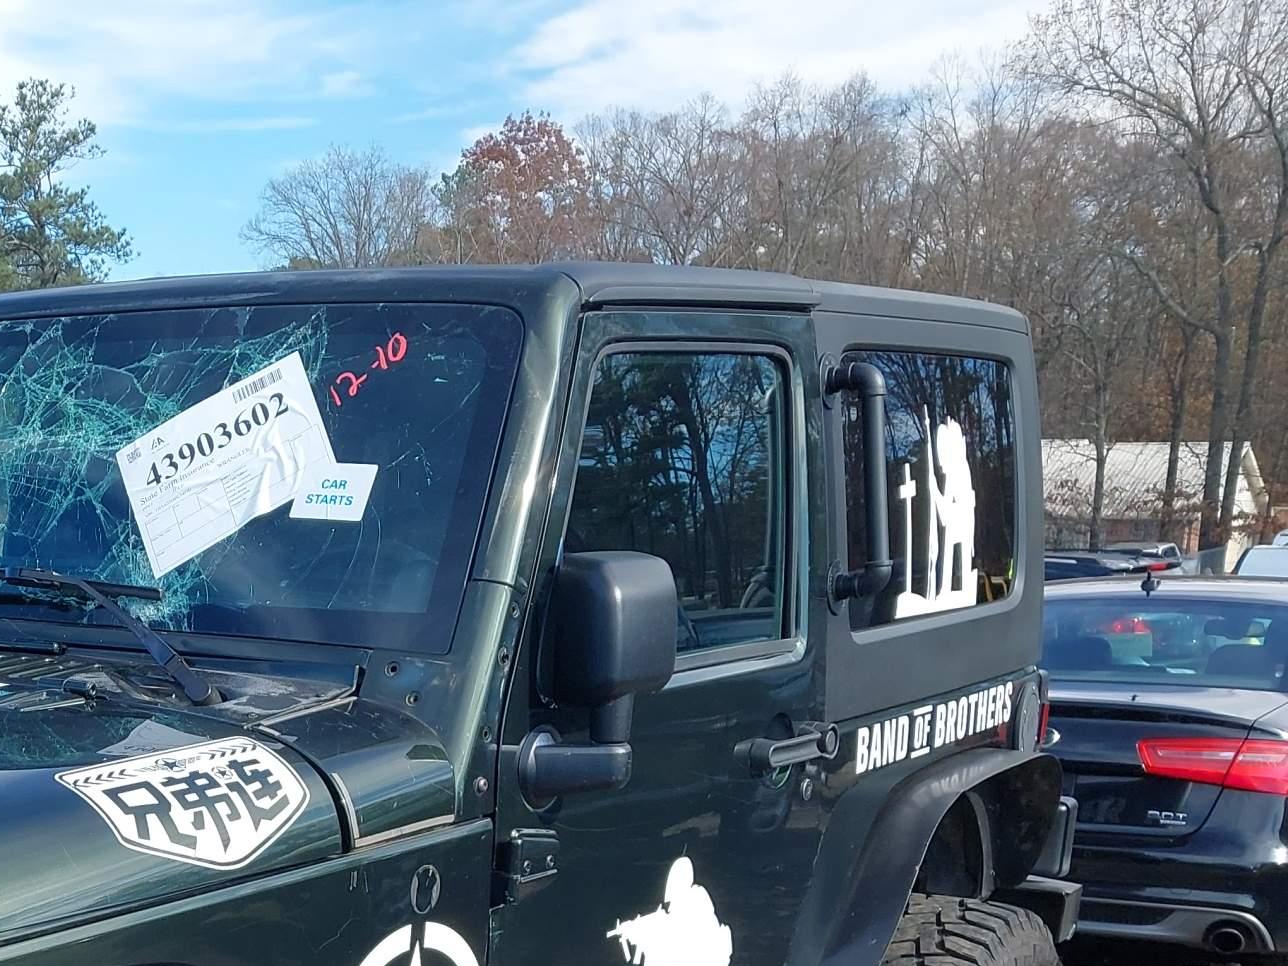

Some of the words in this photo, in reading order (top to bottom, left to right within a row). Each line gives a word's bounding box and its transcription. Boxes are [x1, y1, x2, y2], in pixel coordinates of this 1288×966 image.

[330, 332, 408, 406] 12-10
[145, 391, 289, 487] 43903602
[140, 488, 158, 506] State
[159, 478, 178, 494] Farm
[304, 493, 354, 507] STARTS
[320, 478, 348, 490] CAR
[855, 711, 910, 775] BAND
[913, 709, 933, 754] OF
[934, 682, 1013, 745] BROTHERS
[101, 758, 291, 855] 兄弟连
